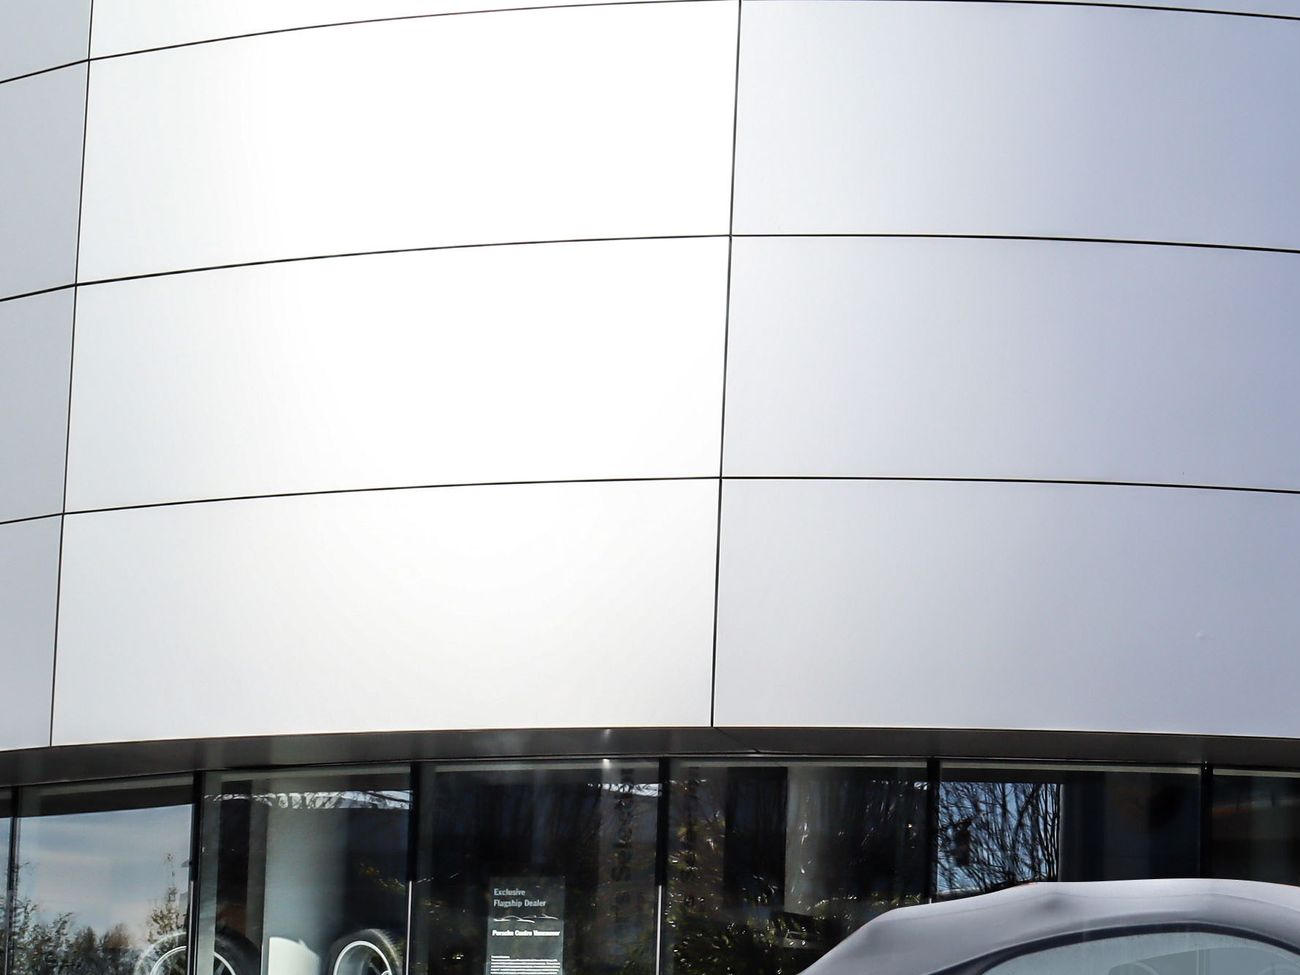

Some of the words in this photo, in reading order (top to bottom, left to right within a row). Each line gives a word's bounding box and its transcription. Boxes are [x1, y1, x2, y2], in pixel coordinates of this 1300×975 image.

[493, 887, 526, 896] Exclusive
[493, 899, 523, 908] Flagship
[524, 899, 546, 907] Dealer
